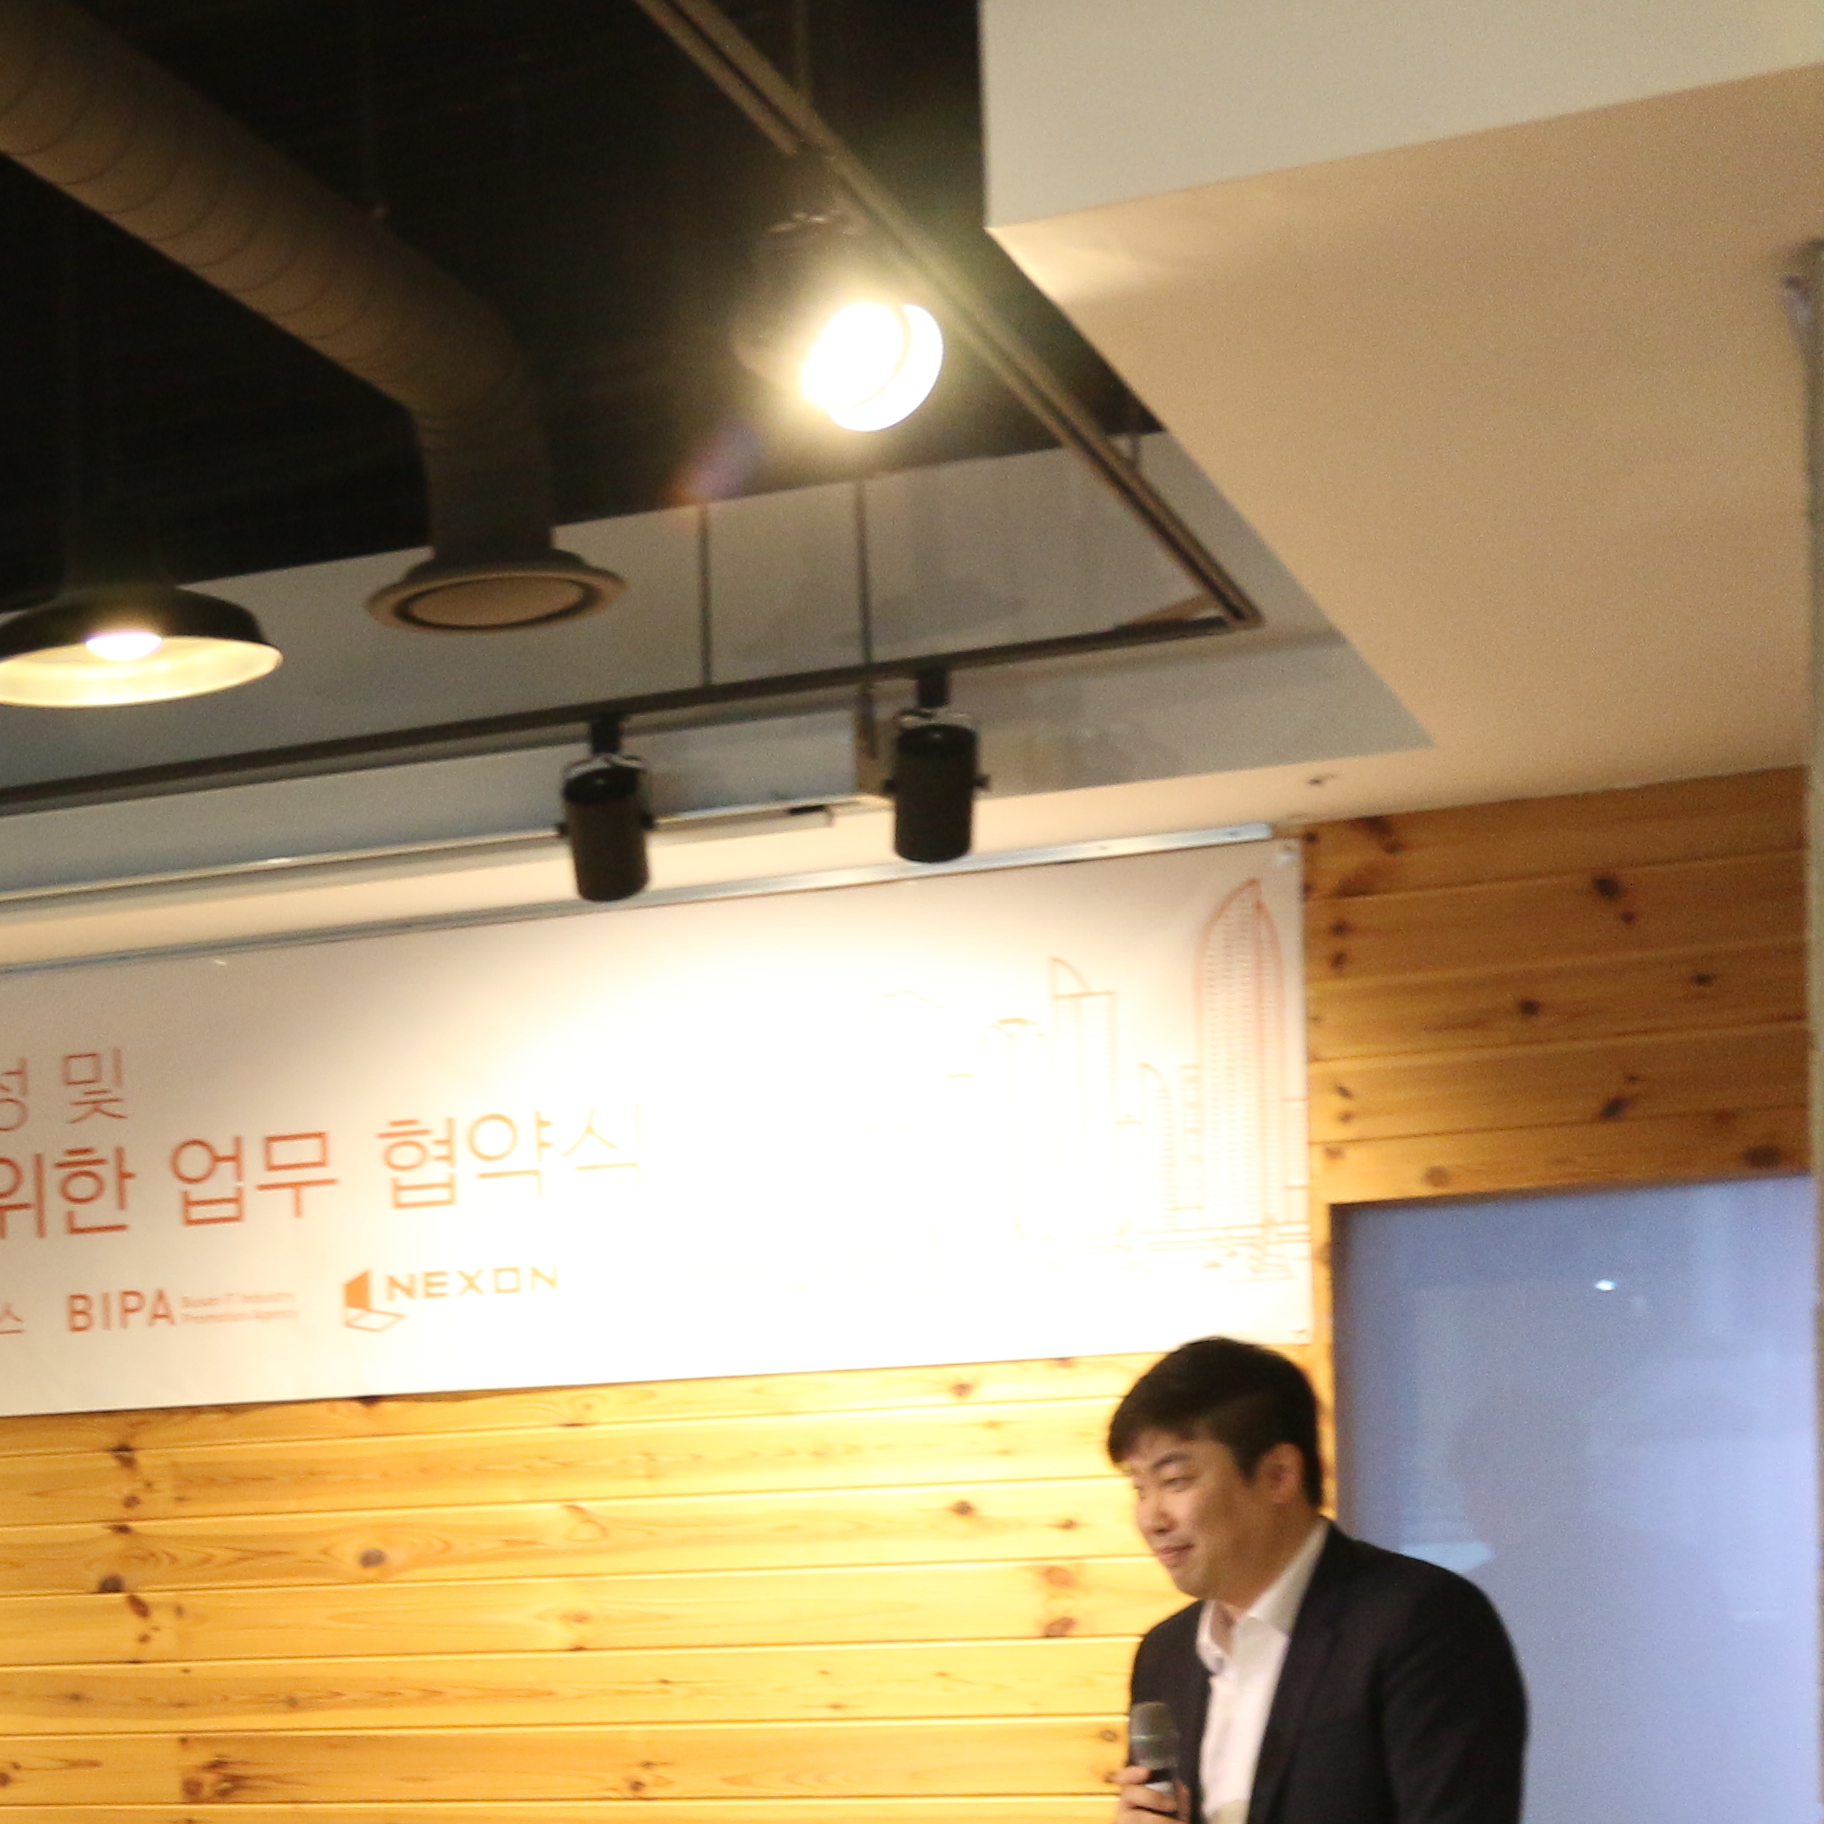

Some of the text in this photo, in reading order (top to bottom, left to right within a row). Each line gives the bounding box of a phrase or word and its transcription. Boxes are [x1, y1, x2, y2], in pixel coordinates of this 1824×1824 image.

[59, 1047, 127, 1125] 및
[169, 1130, 339, 1228] 업무
[65, 1288, 176, 1333] BIPA
[385, 1265, 560, 1302] NEXON
